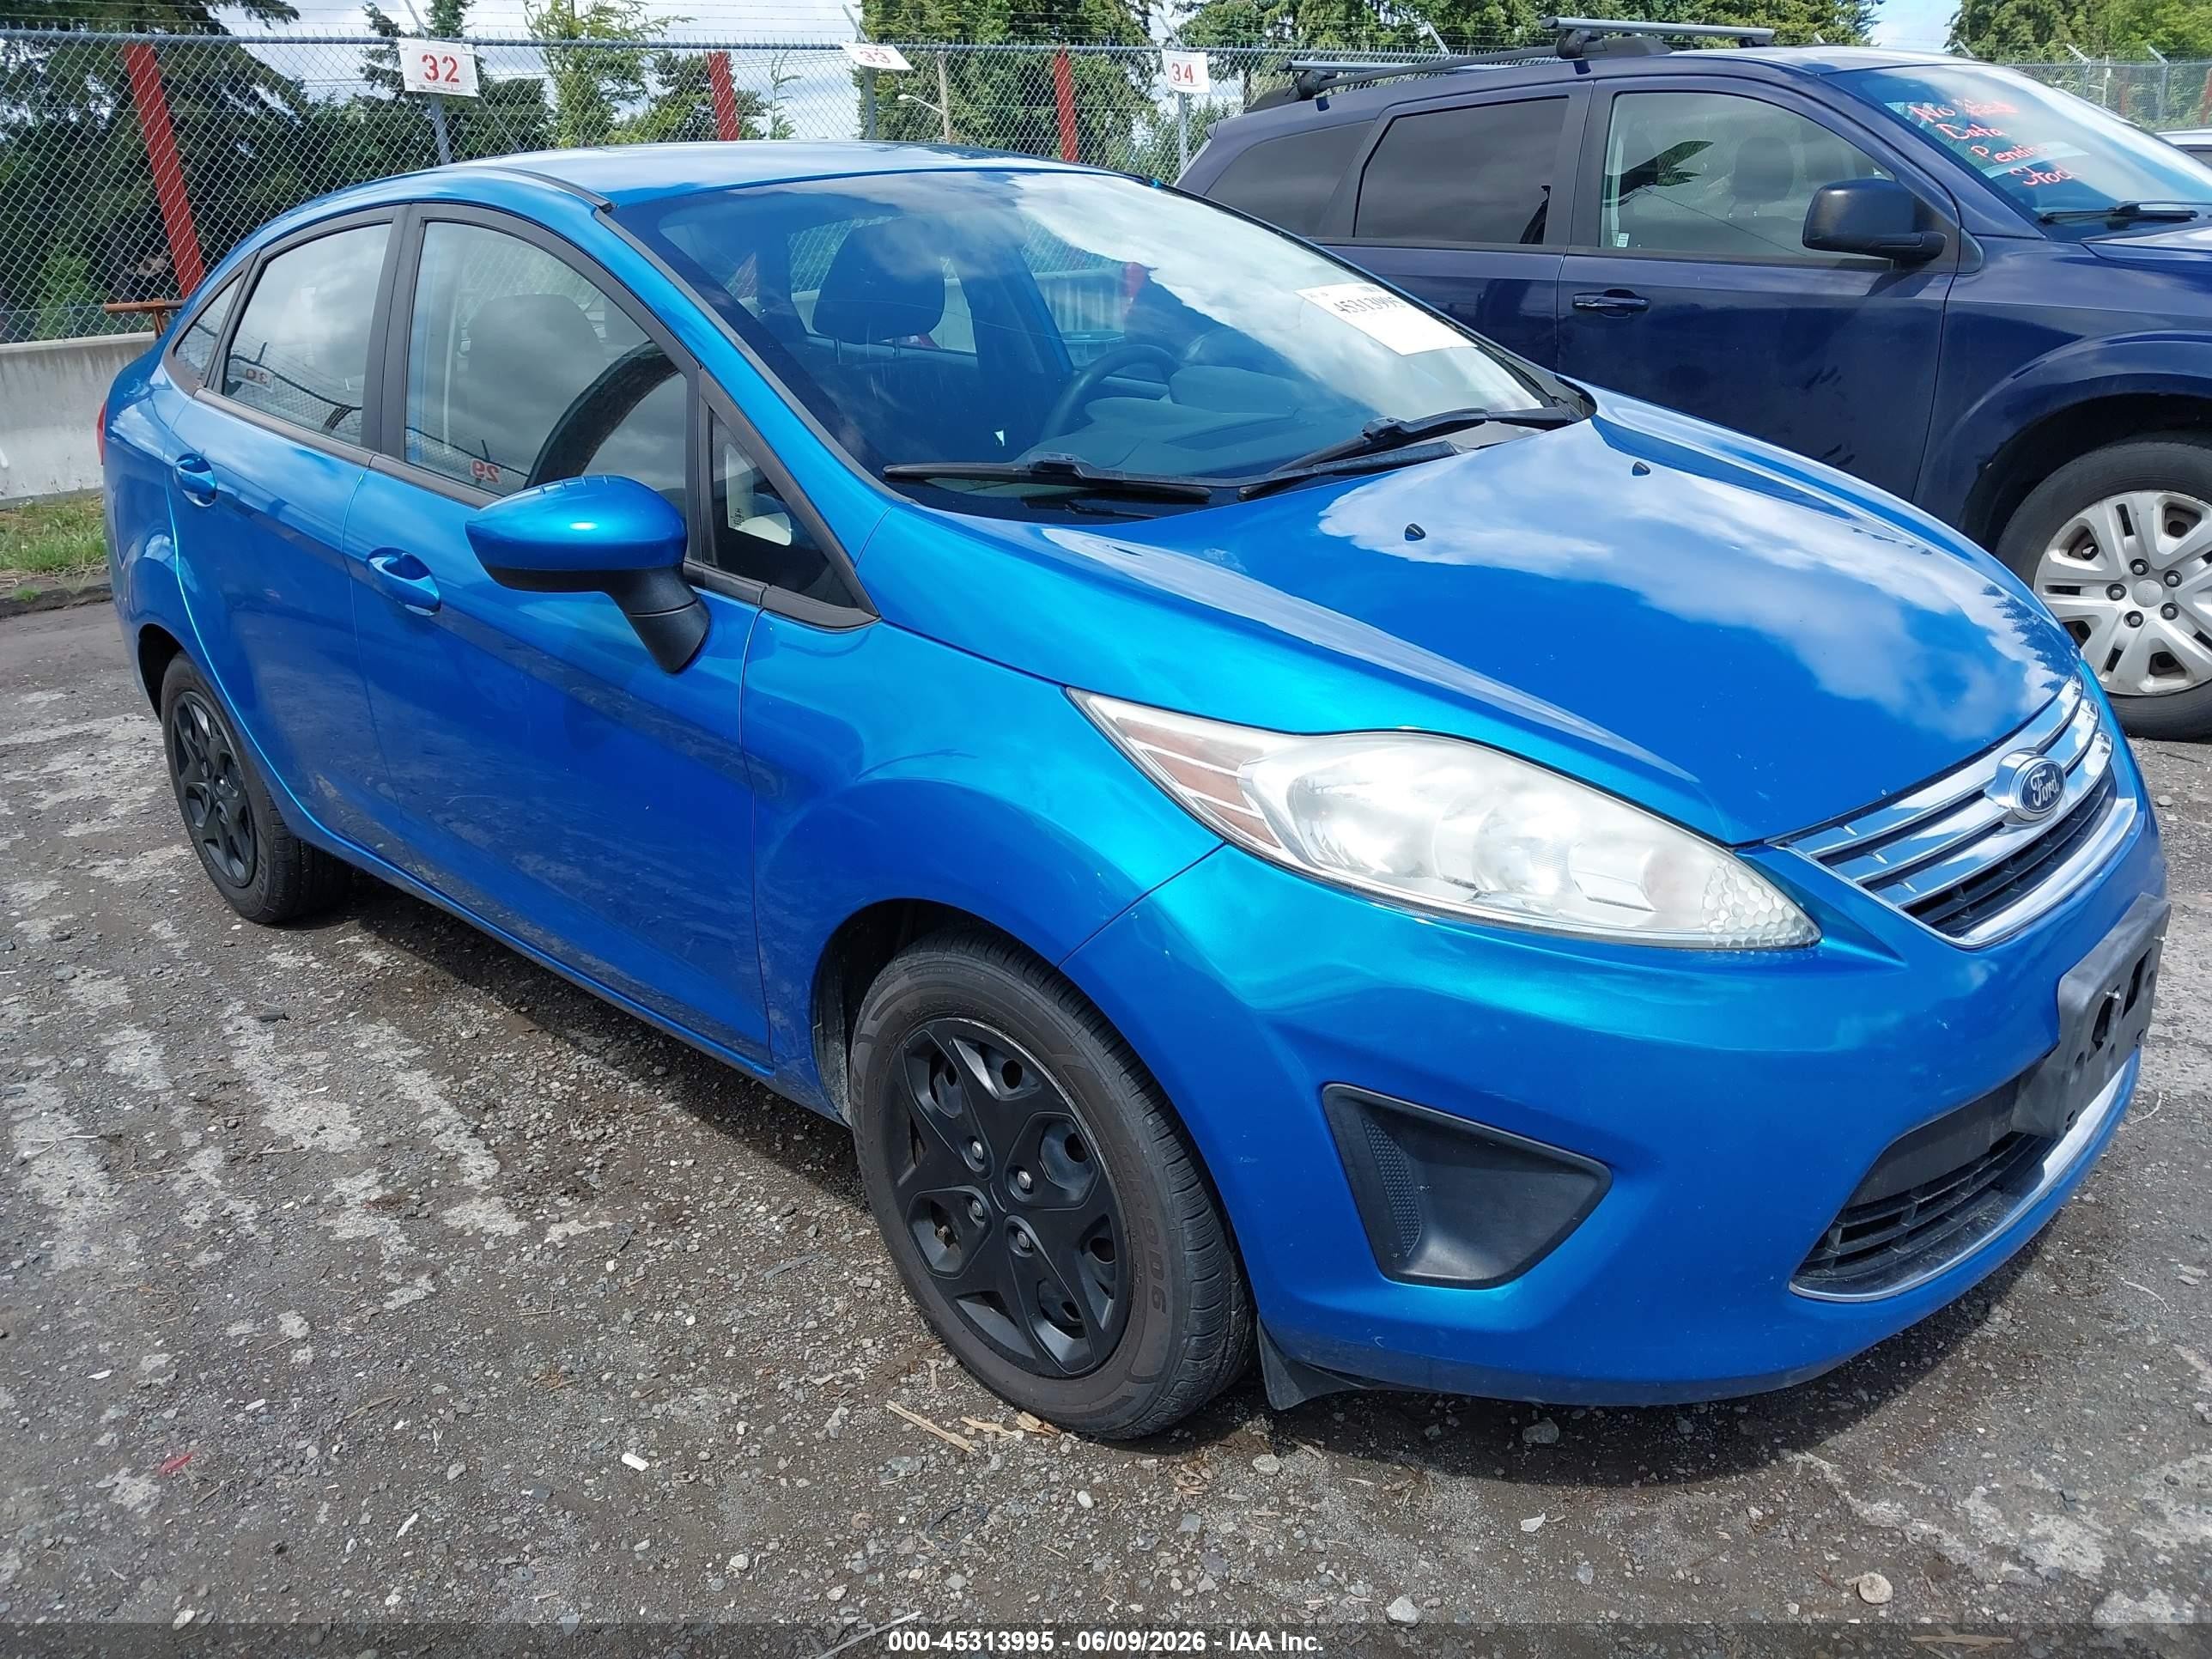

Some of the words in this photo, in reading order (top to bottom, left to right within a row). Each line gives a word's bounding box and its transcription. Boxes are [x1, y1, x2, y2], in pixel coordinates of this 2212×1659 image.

[422, 54, 460, 82] 32
[860, 51, 891, 64] 33
[1171, 63, 1194, 83] 34
[1908, 102, 1956, 123] No
[2031, 769, 2059, 806] Ford
